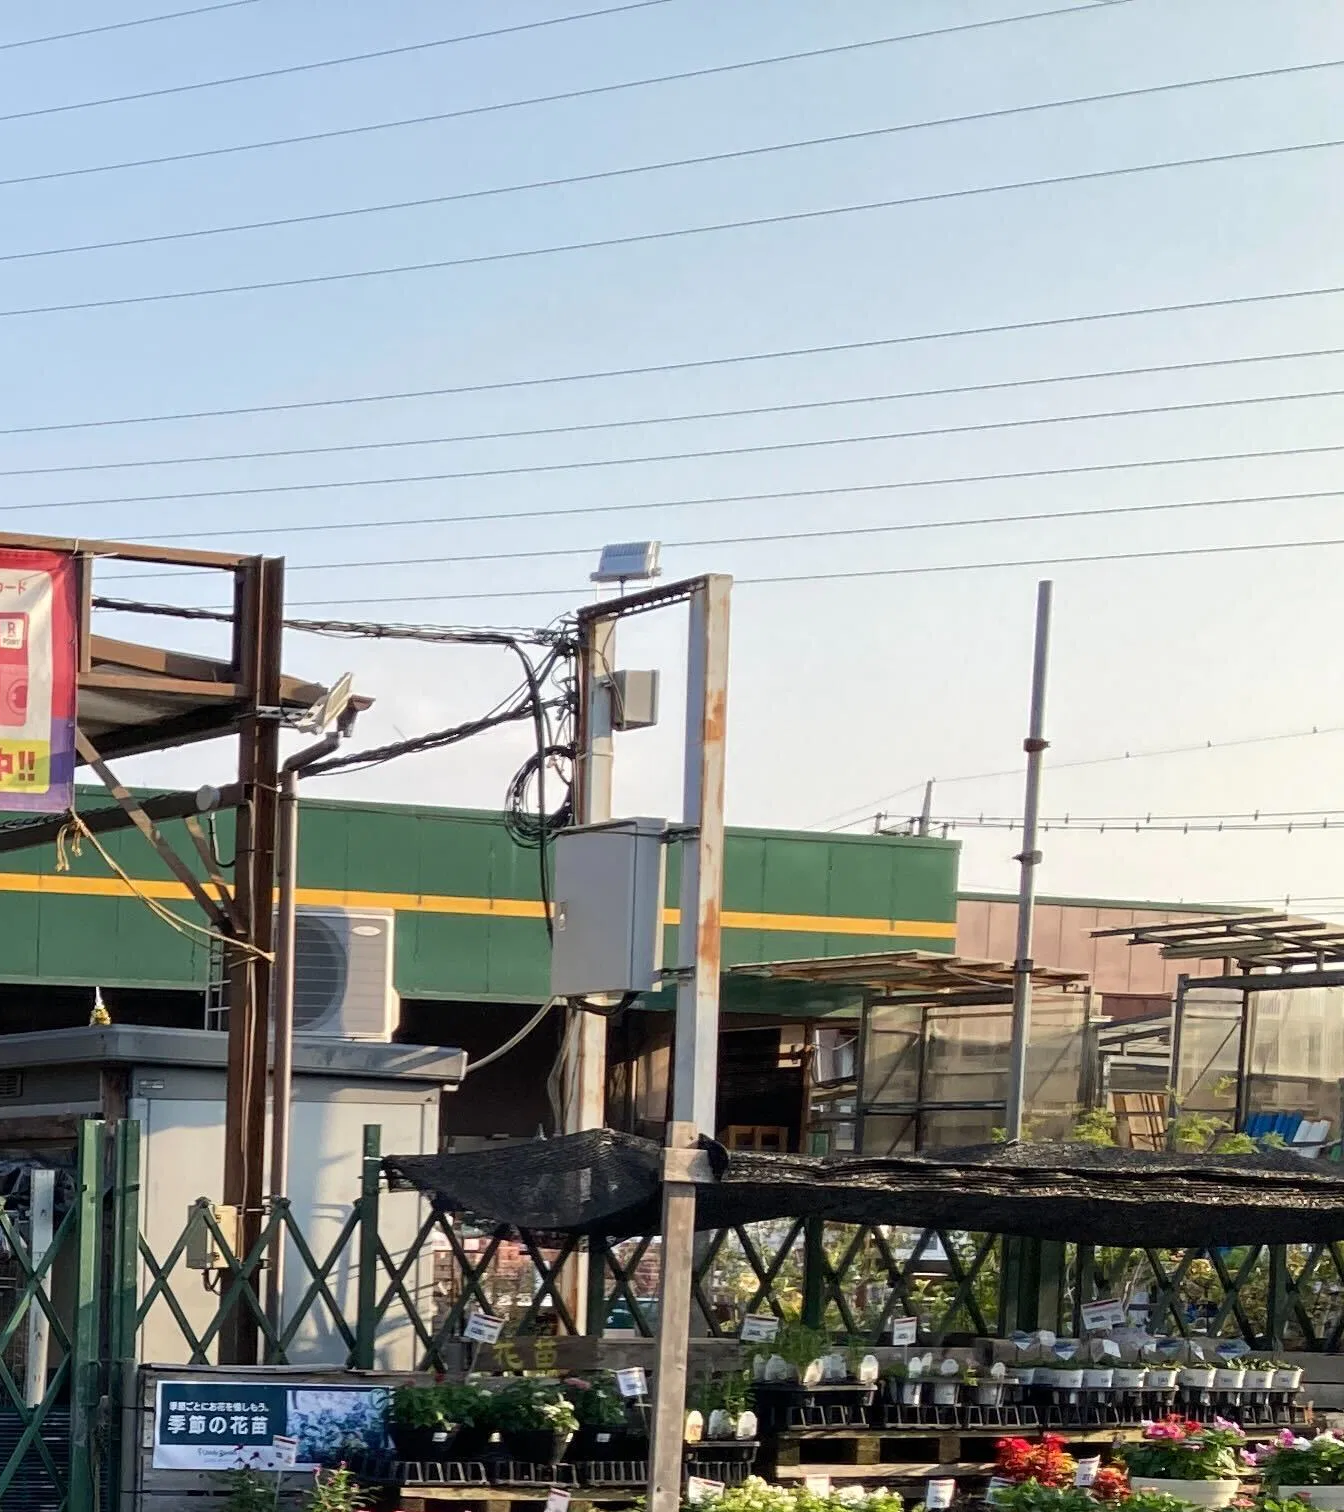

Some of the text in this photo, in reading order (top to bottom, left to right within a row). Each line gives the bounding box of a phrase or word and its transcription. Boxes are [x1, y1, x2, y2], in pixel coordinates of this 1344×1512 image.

[167, 1414, 269, 1435] 季節の花苗
